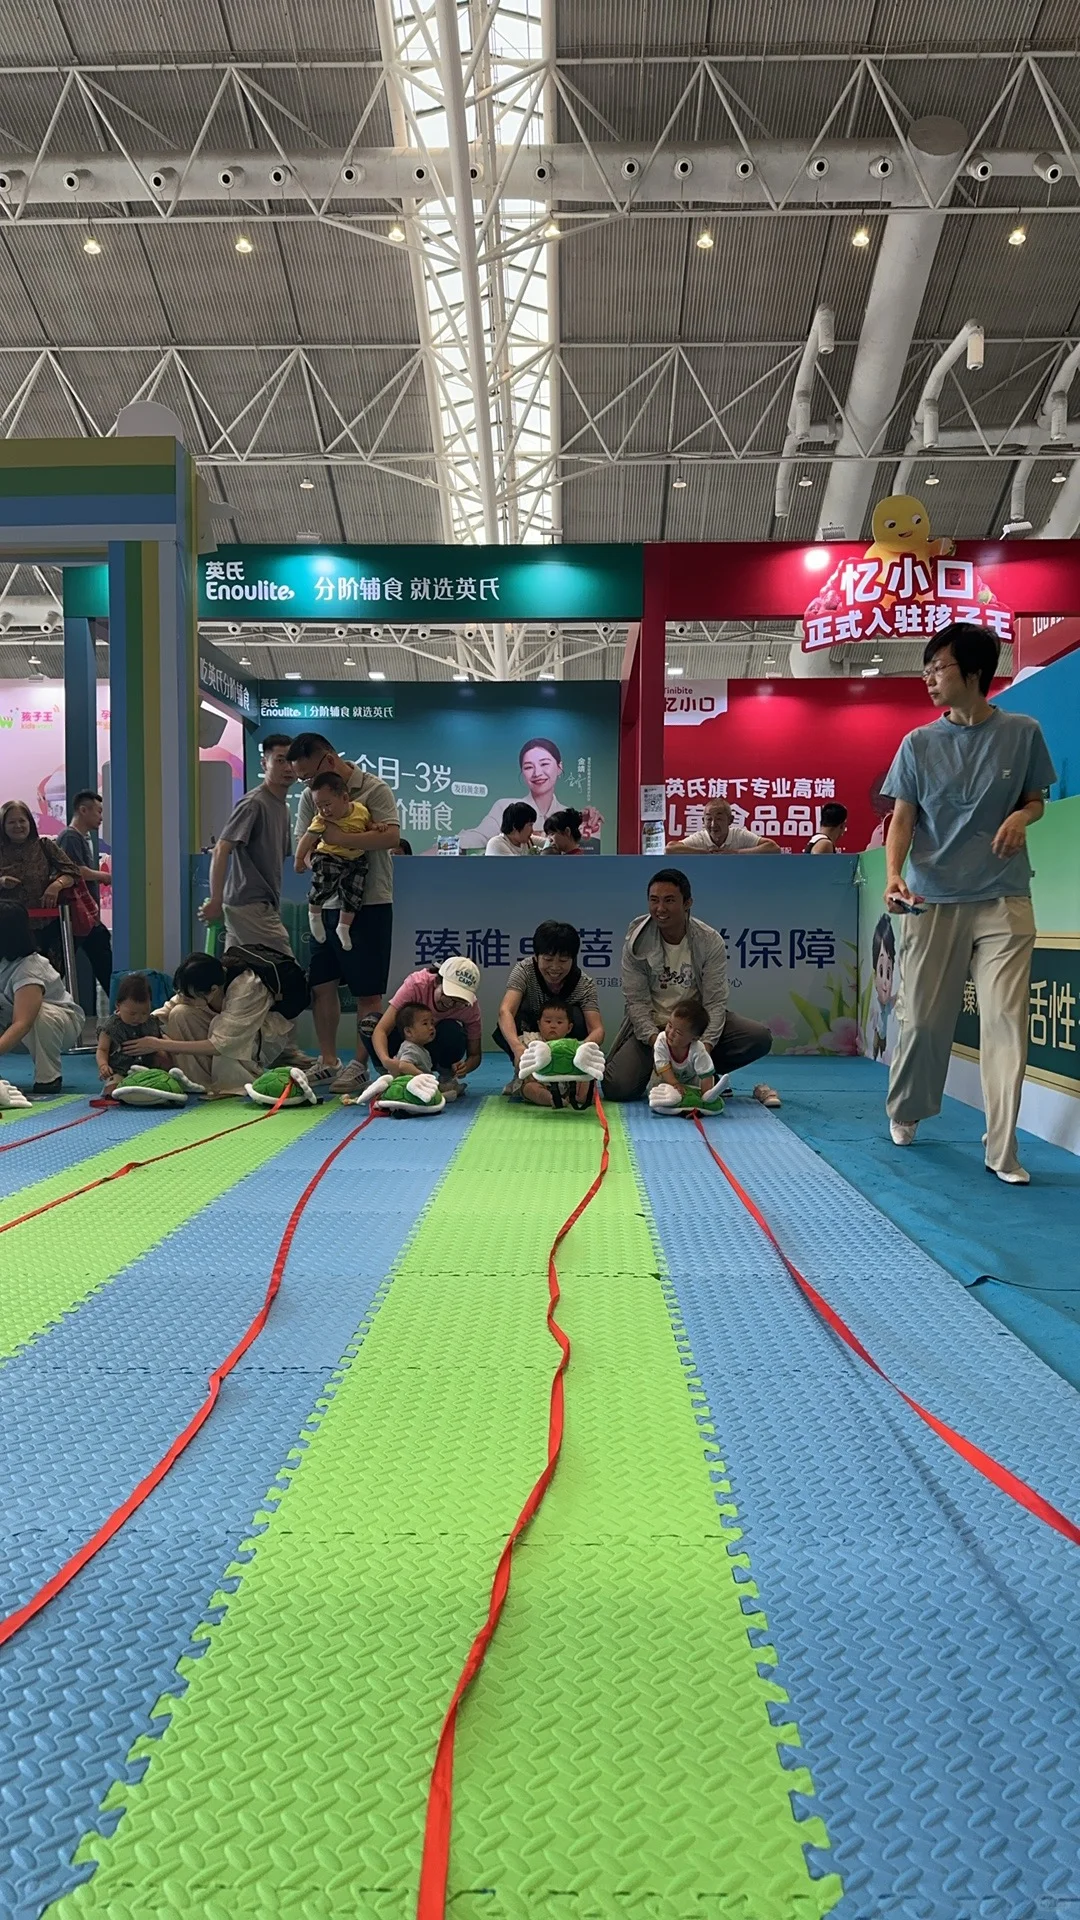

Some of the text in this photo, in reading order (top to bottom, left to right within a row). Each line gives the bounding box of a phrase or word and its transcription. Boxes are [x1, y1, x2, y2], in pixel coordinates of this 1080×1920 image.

[206, 561, 244, 580] 英氏
[206, 579, 294, 600] Enoulite
[314, 576, 500, 600] 分阶辅食 就选英氏
[841, 558, 974, 605] 忆小口
[261, 699, 279, 708] 英氏
[261, 707, 301, 717] Enoulite
[310, 706, 393, 718] 分阶辅食 就选英氏
[21, 711, 54, 722] 孩子王
[665, 777, 836, 799] 英氏旗下专业高端
[595, 977, 743, 989] 可追 心
[1028, 980, 1080, 1052] 活性
